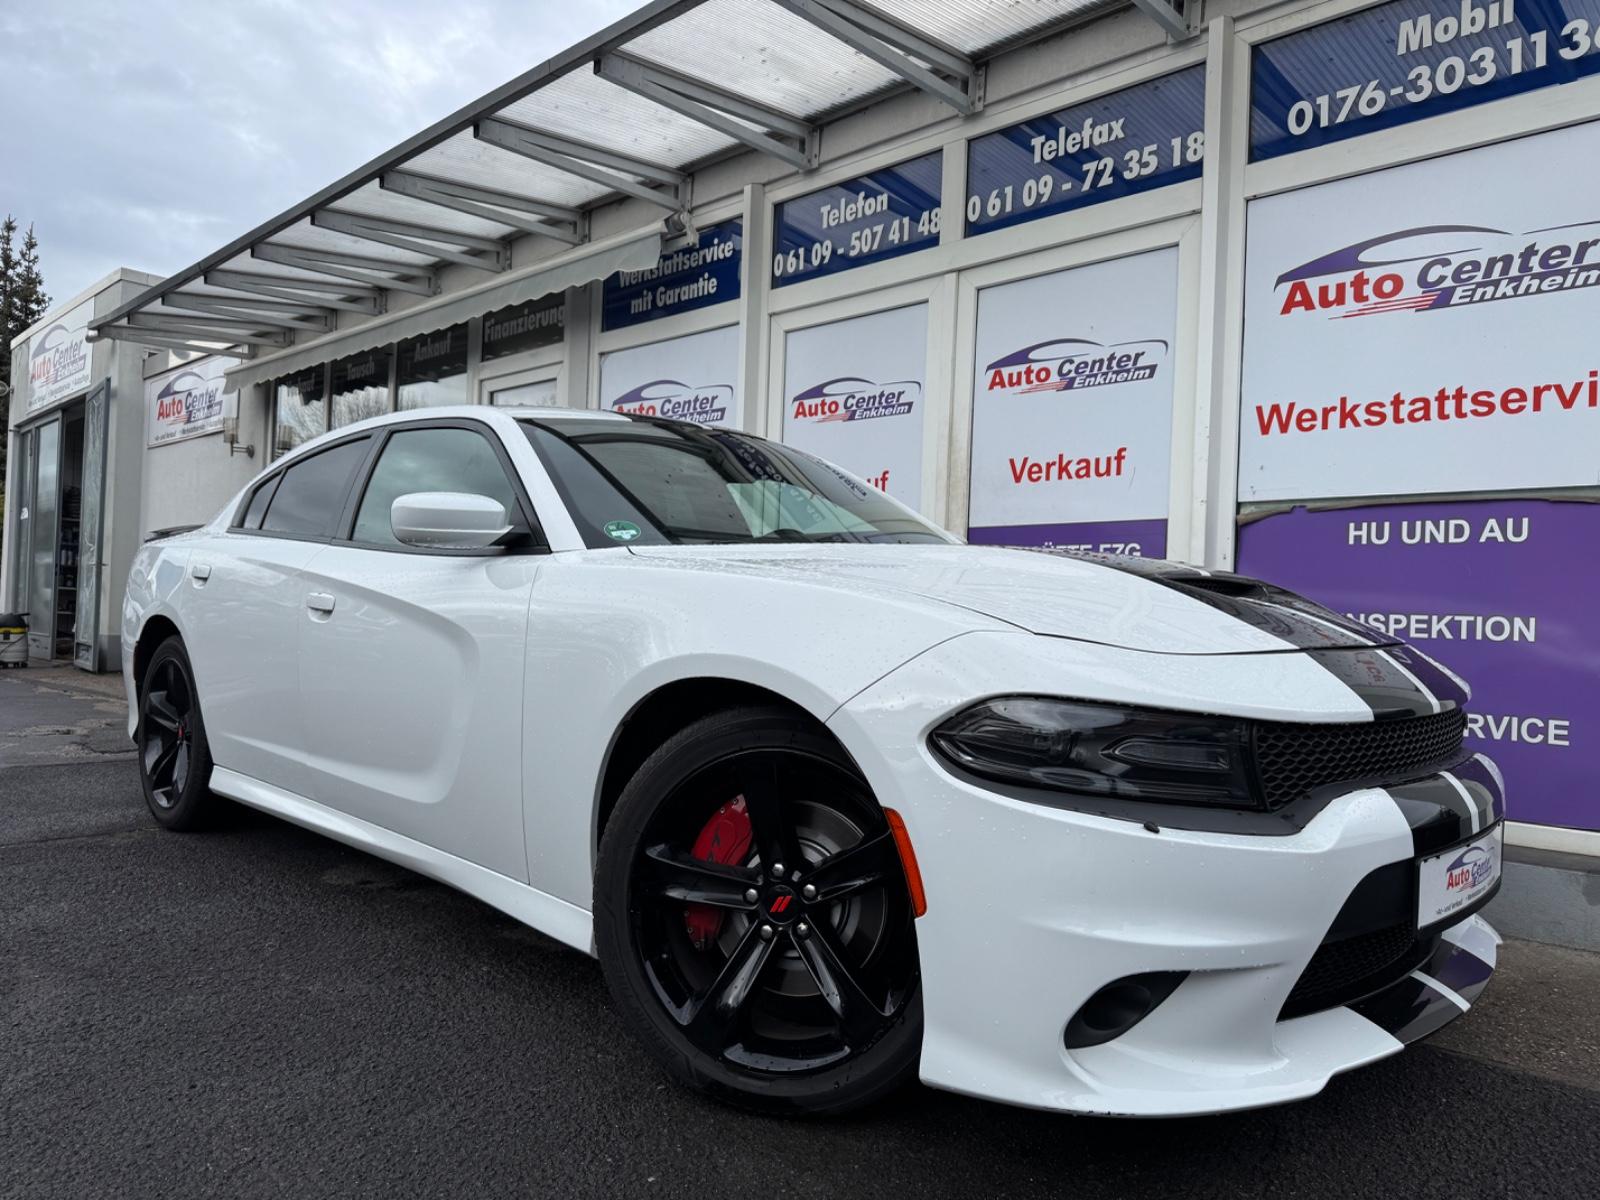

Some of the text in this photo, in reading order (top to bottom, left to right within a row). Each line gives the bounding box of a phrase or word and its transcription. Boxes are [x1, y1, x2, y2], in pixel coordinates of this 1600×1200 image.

[1397, 0, 1514, 55] Mobil
[1030, 117, 1126, 165] Telefax
[1022, 174, 1054, 207] 09
[1081, 157, 1115, 193] 72
[1123, 144, 1159, 180] 35
[1170, 131, 1204, 168] 18
[820, 191, 889, 229] Telefon
[811, 240, 833, 267] 09
[849, 223, 885, 257] 507
[888, 216, 910, 244] 41
[917, 207, 941, 236] 48
[630, 273, 718, 314] mit Garantie
[1280, 237, 1600, 316] Auto Center
[484, 305, 566, 343] Finanzierung
[30, 355, 51, 385] Auto
[53, 338, 84, 369] Center
[988, 351, 1146, 391] Auto Center
[1073, 366, 1151, 389] Enkheim
[157, 387, 219, 421] Auto Center
[616, 394, 719, 417] to Center
[794, 390, 906, 419] Auto Center
[854, 403, 909, 420] Enkheim
[1008, 446, 1127, 484] Verkauf
[1348, 517, 1529, 545] HU UND AU
[1346, 613, 1536, 643] SPEKTION
[1446, 868, 1470, 891] Auto
